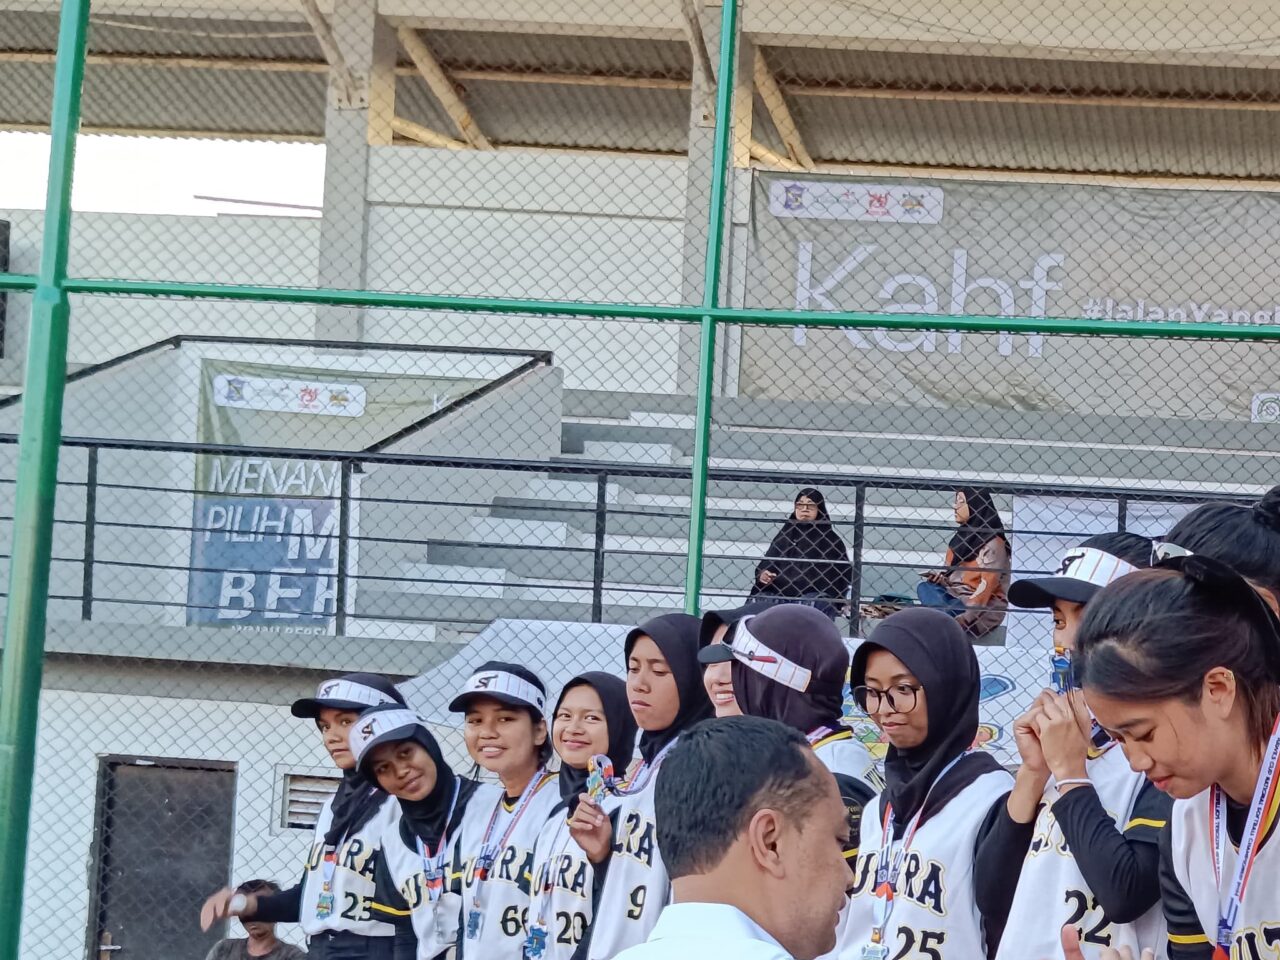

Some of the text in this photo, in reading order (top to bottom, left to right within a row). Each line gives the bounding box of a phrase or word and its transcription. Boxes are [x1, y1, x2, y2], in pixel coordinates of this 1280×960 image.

[792, 240, 1065, 358] Kahf
[204, 505, 288, 543] PILIH
[627, 884, 648, 921] 9
[556, 910, 588, 945] 20
